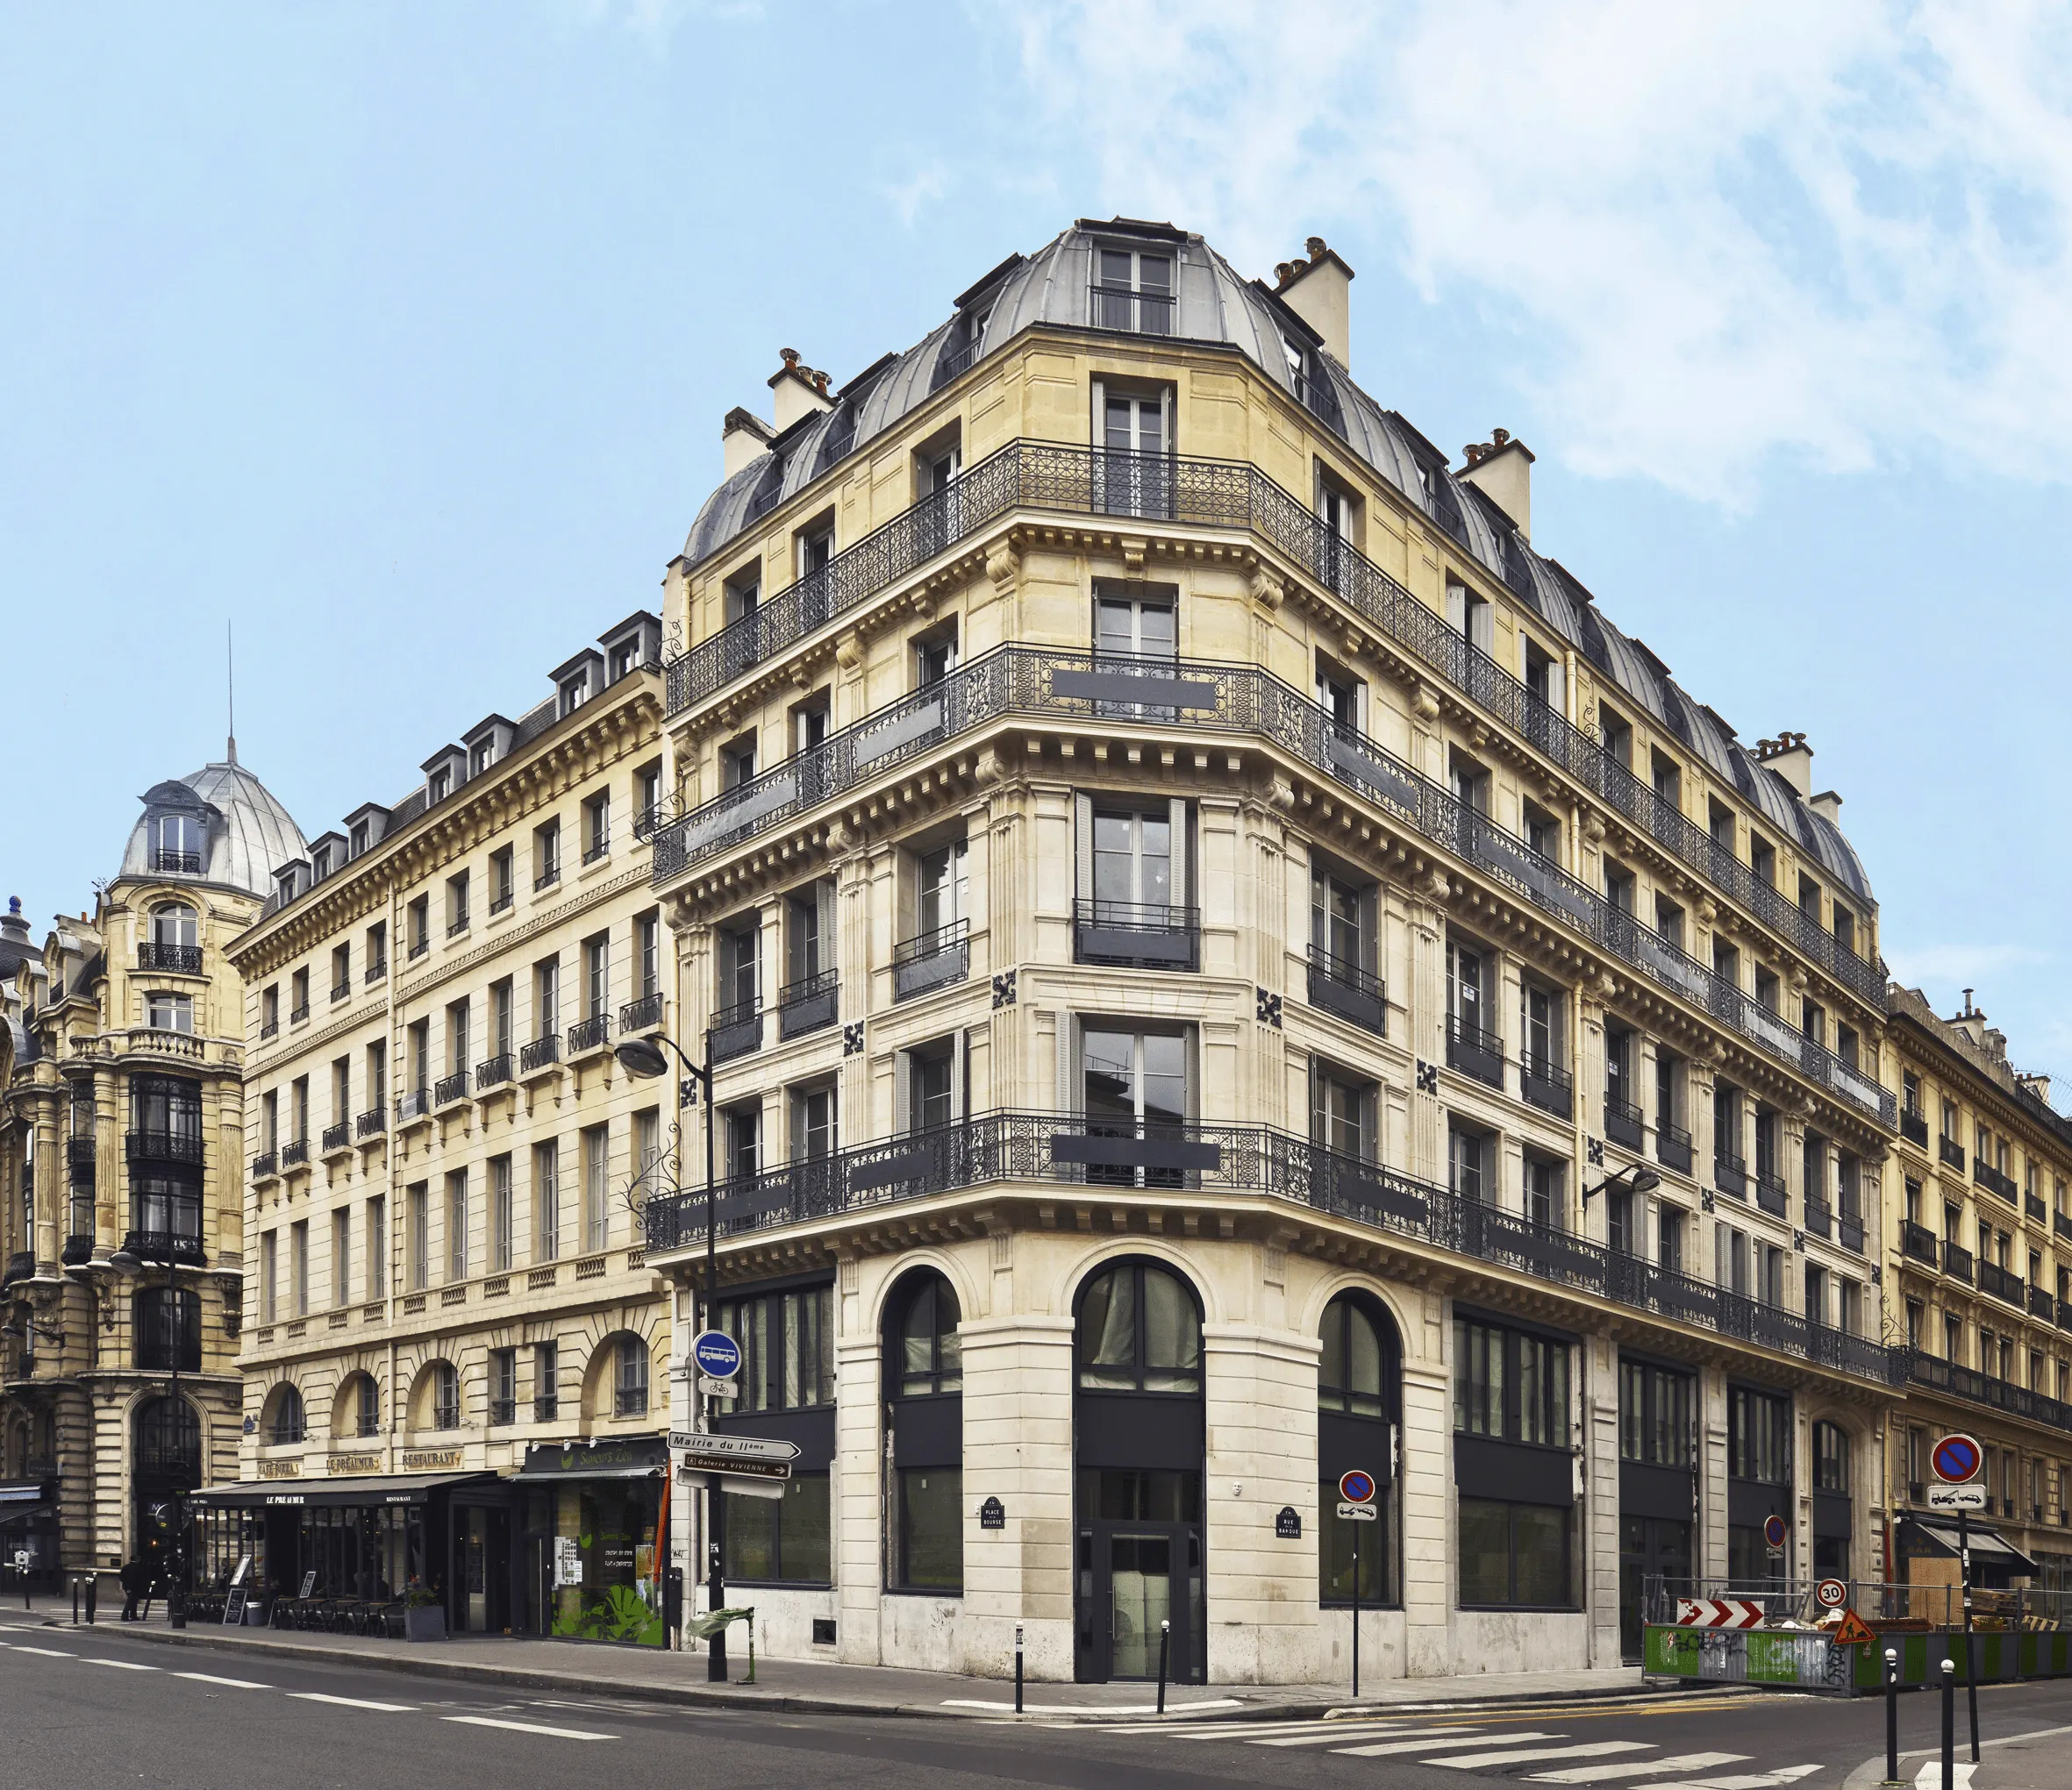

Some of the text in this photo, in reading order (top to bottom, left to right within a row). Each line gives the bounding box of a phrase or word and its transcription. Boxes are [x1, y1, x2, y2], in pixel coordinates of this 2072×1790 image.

[674, 1436, 713, 1448] Mairie
[720, 1440, 733, 1450] du
[402, 1451, 455, 1466] RESTAURANT
[730, 1462, 767, 1472] VIVIENNE
[1822, 1587, 1840, 1599] 30
